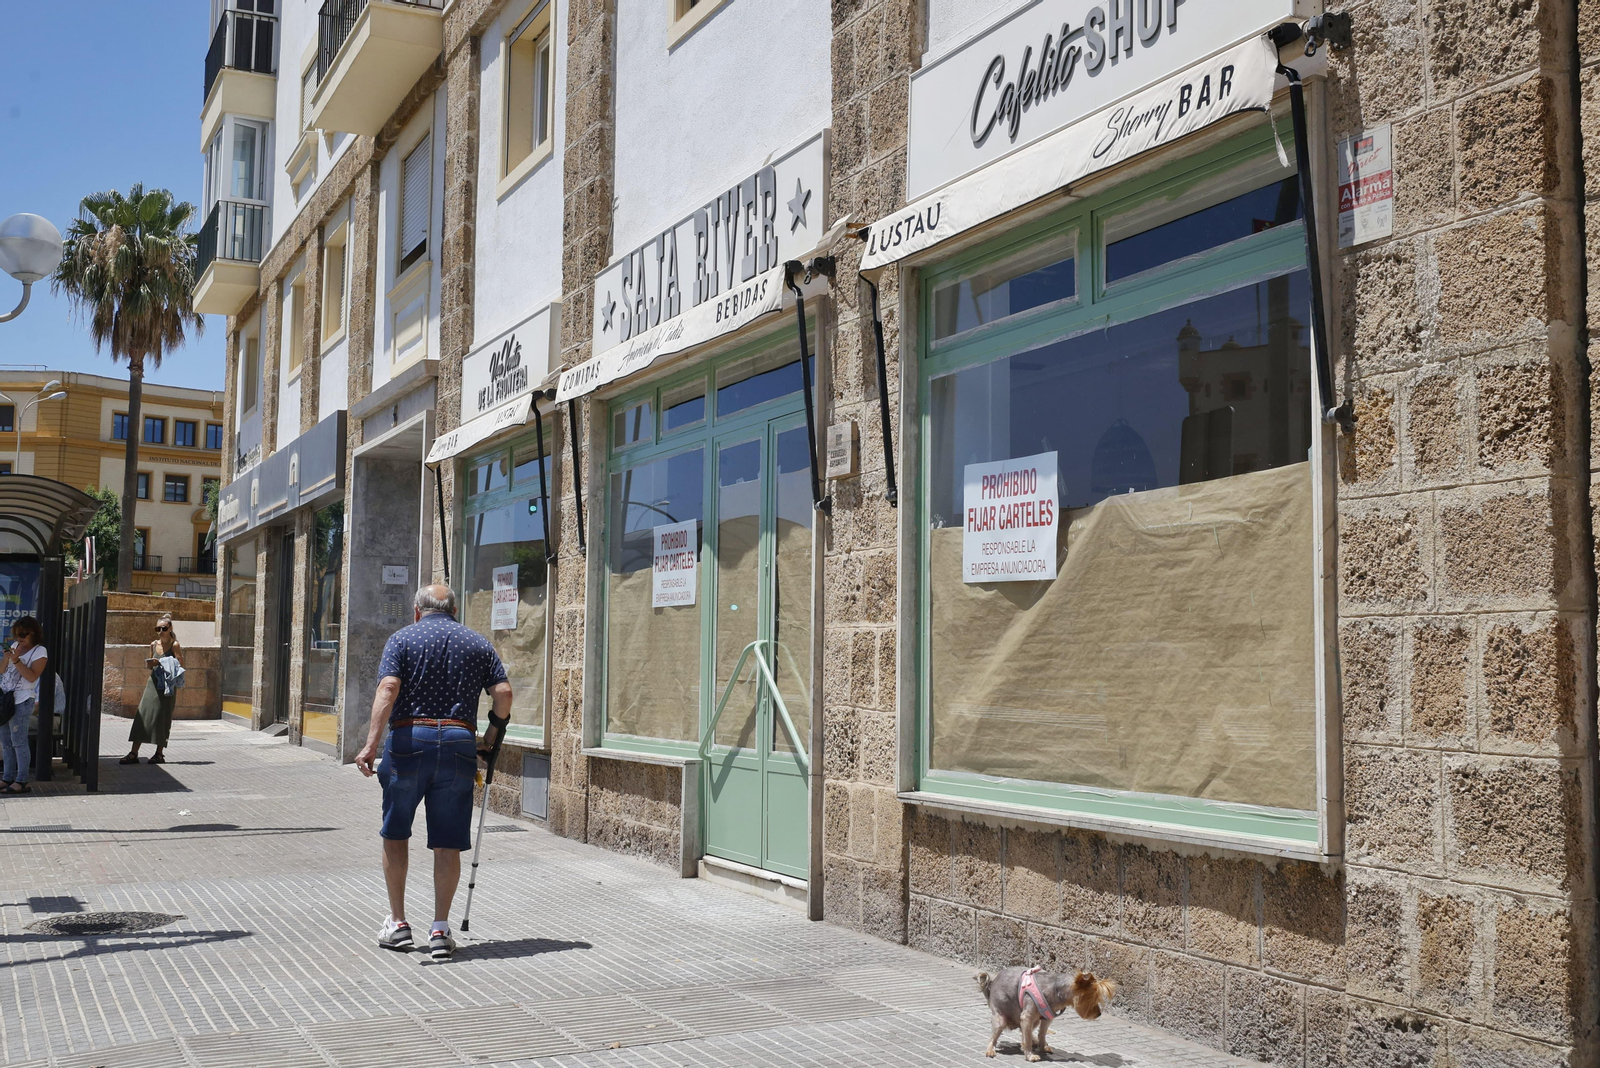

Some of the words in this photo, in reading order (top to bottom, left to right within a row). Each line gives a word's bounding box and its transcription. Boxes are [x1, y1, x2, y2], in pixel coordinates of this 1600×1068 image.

[970, 22, 1084, 146] Cafelito
[1092, 100, 1173, 159] Sherry
[1178, 64, 1235, 119] BAR
[1341, 178, 1390, 202] Alarma
[867, 202, 941, 256] LUSTAU
[619, 226, 681, 343] SAJA
[692, 164, 778, 308] RIVER
[715, 278, 769, 323] BEBIDAS
[563, 360, 601, 392] COMIDAS
[149, 456, 178, 464] INSTITUTO
[981, 468, 1037, 500] PROHIBIDO
[968, 506, 996, 532] FIJAR
[999, 499, 1053, 530] CARTELES
[661, 530, 687, 551] PROHIBIDO
[981, 540, 1026, 555] RESPONSABLE
[1027, 539, 1036, 552] LA
[655, 554, 669, 573] FIJAR
[669, 551, 694, 571] CARTELES
[971, 562, 999, 575] EMPRESA
[1001, 559, 1046, 574] ANUNCIADORA
